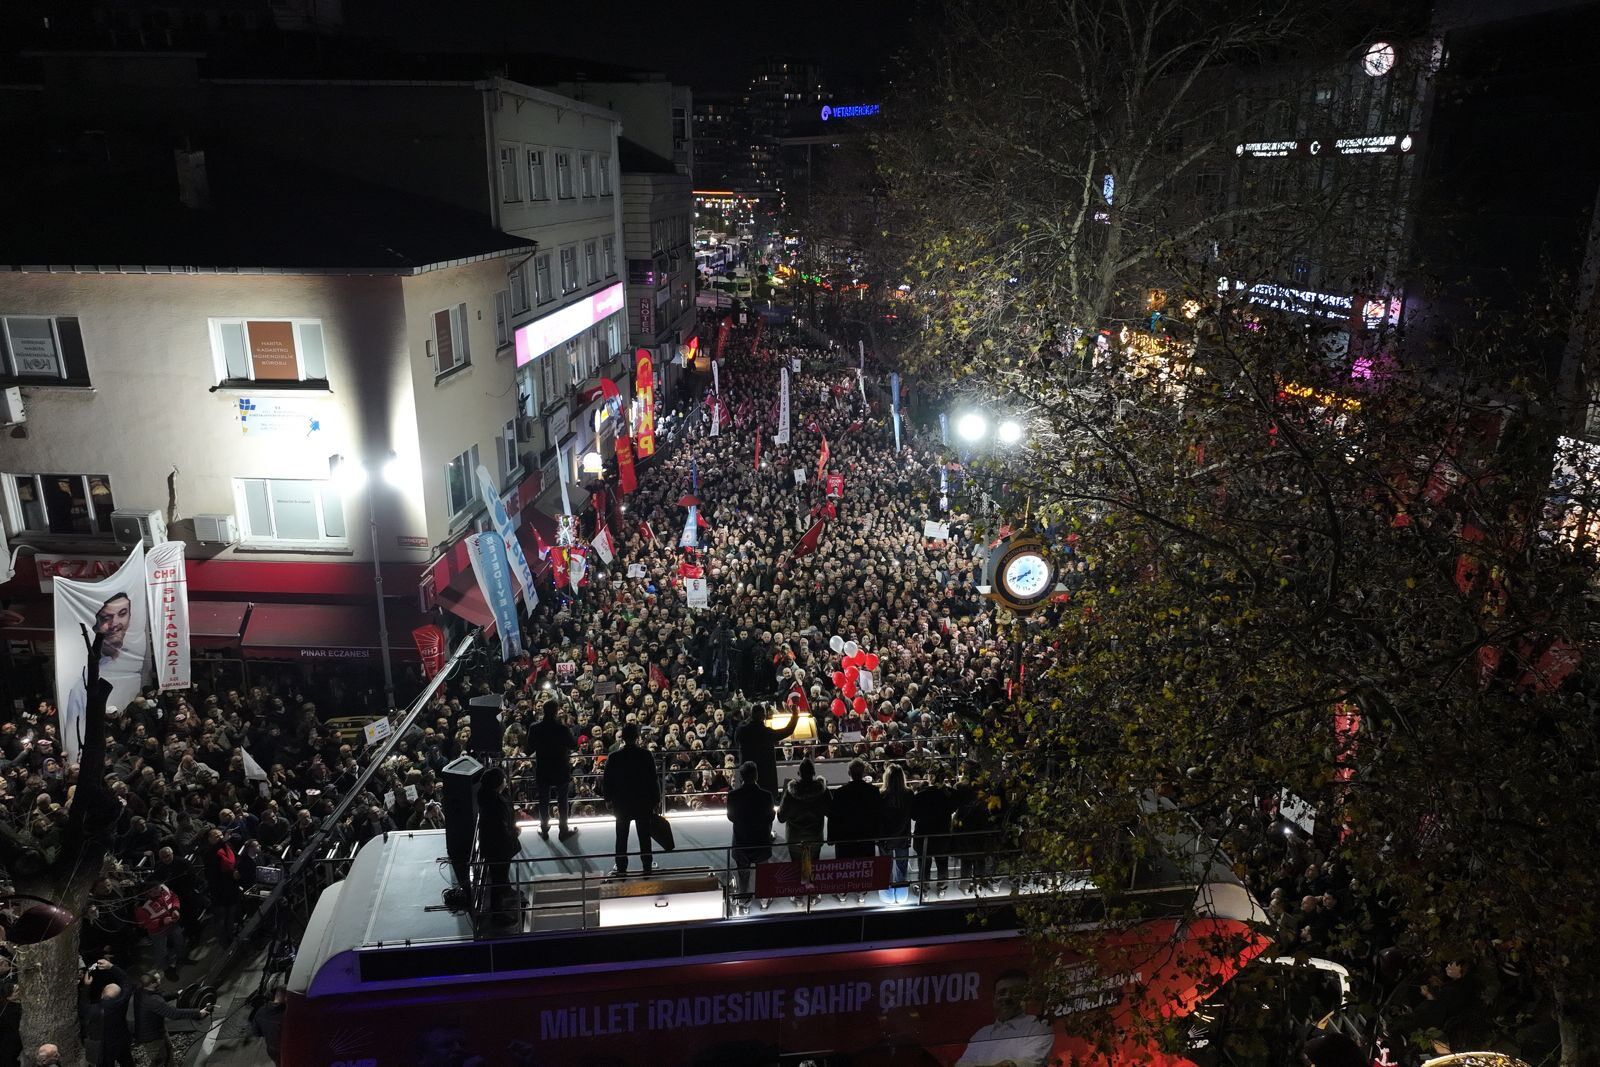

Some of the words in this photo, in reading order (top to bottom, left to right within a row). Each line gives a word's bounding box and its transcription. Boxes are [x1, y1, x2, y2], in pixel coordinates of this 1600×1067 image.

[641, 303, 650, 334] NOTER
[153, 569, 176, 579] CHP
[163, 587, 178, 674] SULTANGAZİ
[300, 649, 327, 657] PINAR
[328, 650, 370, 658] ECZANESİ
